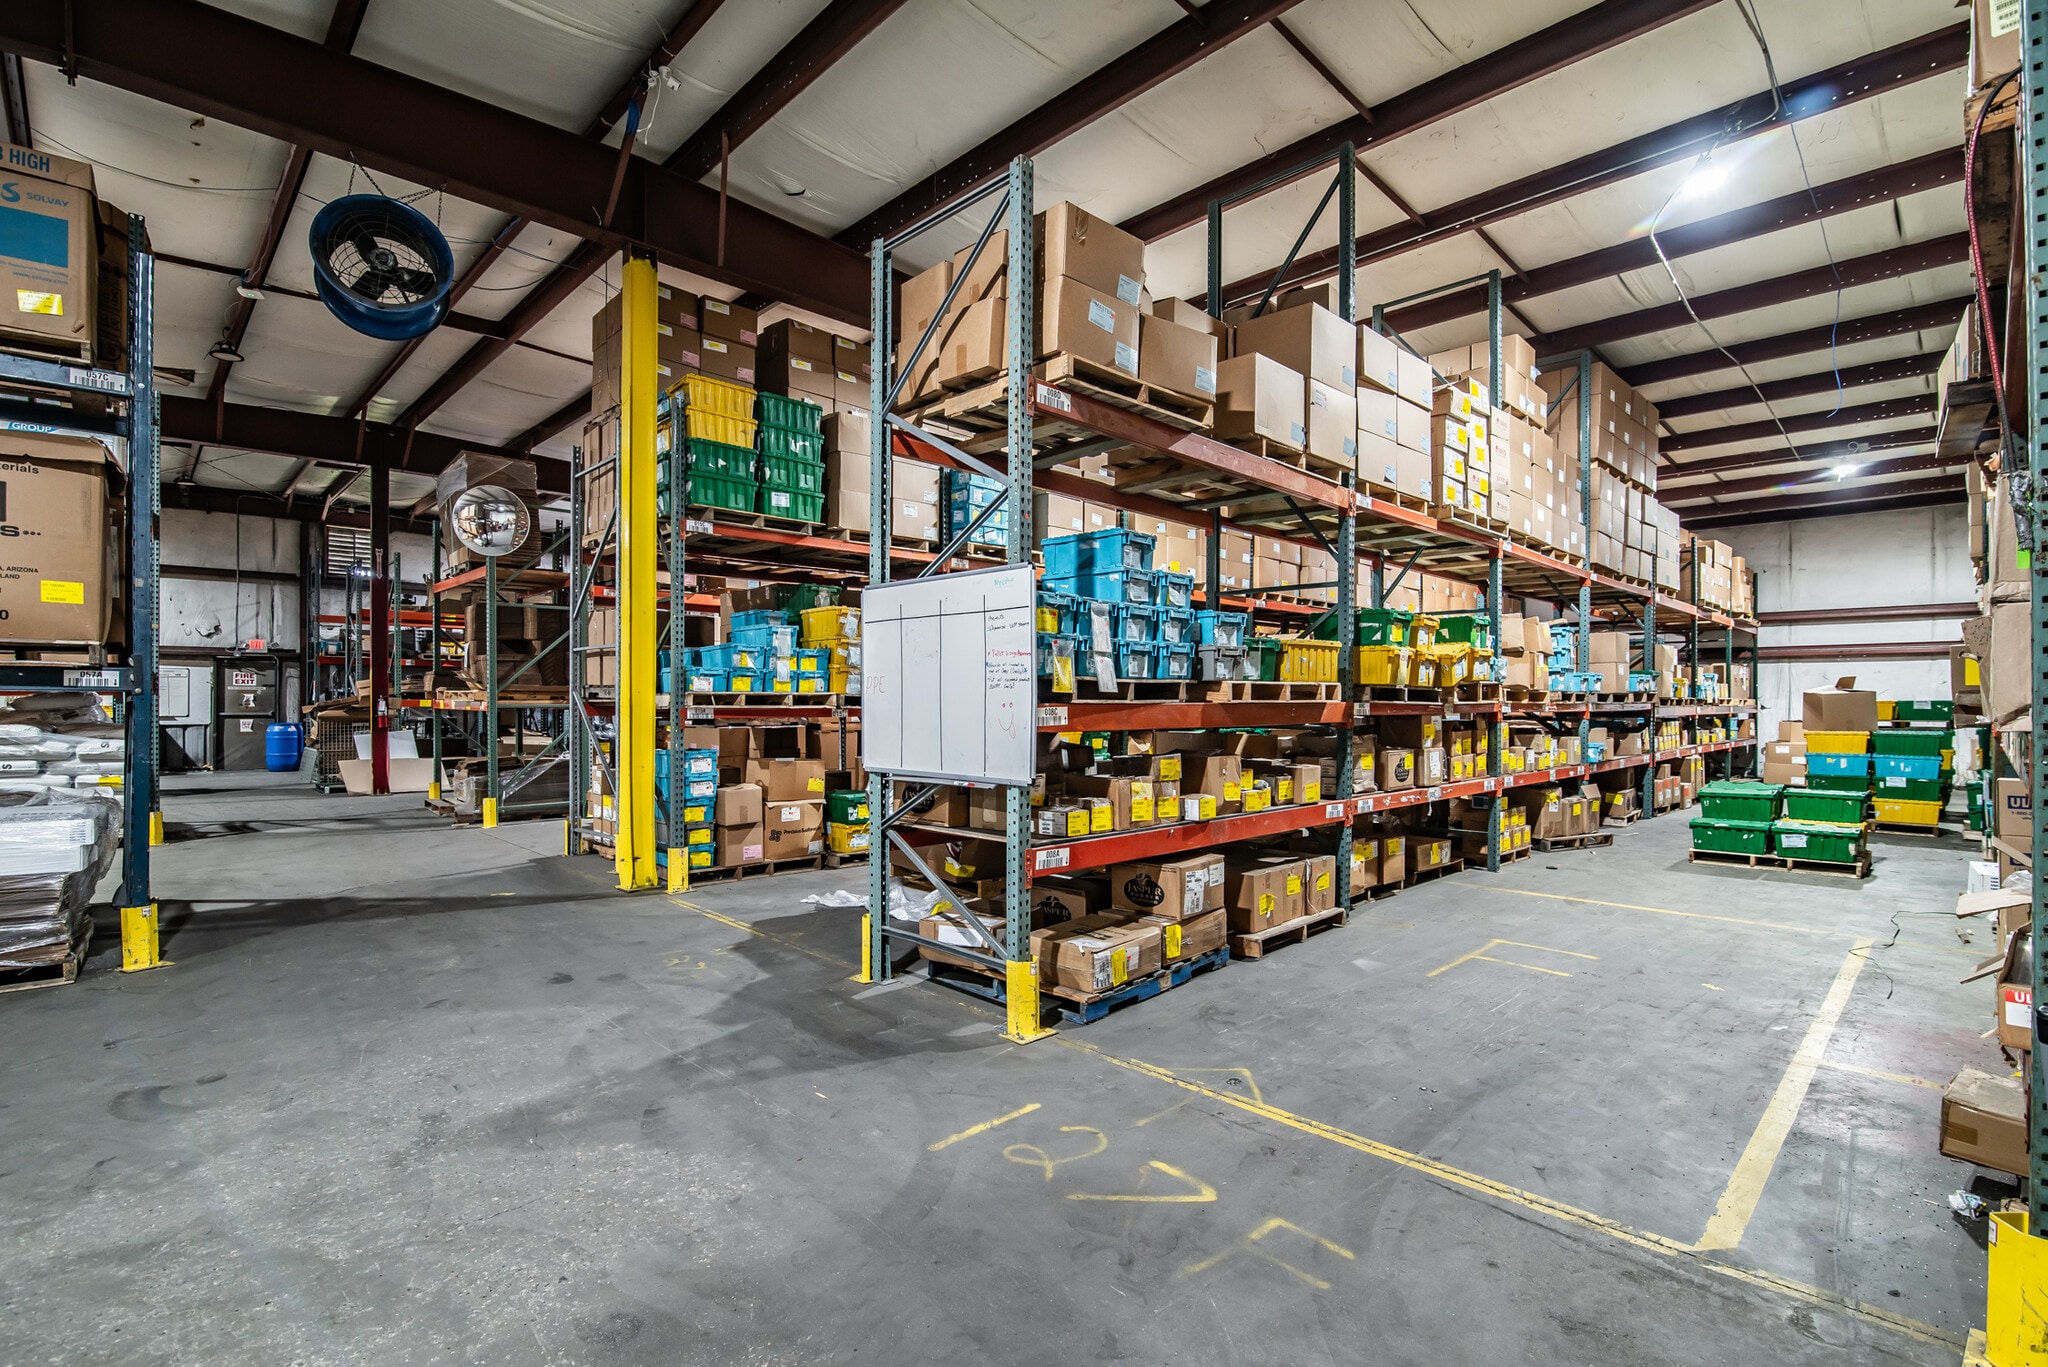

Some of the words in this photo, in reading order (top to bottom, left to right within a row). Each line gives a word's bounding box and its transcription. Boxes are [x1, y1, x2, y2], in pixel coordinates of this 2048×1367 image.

[9, 147, 50, 173] HIGH
[26, 191, 69, 207] SOLVAY
[86, 371, 109, 381] 057C
[11, 422, 52, 432] GROUP
[250, 640, 264, 649] EXIT
[1046, 850, 1060, 859] 008A
[1127, 882, 1162, 896] JASPER
[1043, 905, 1070, 917] ASPER
